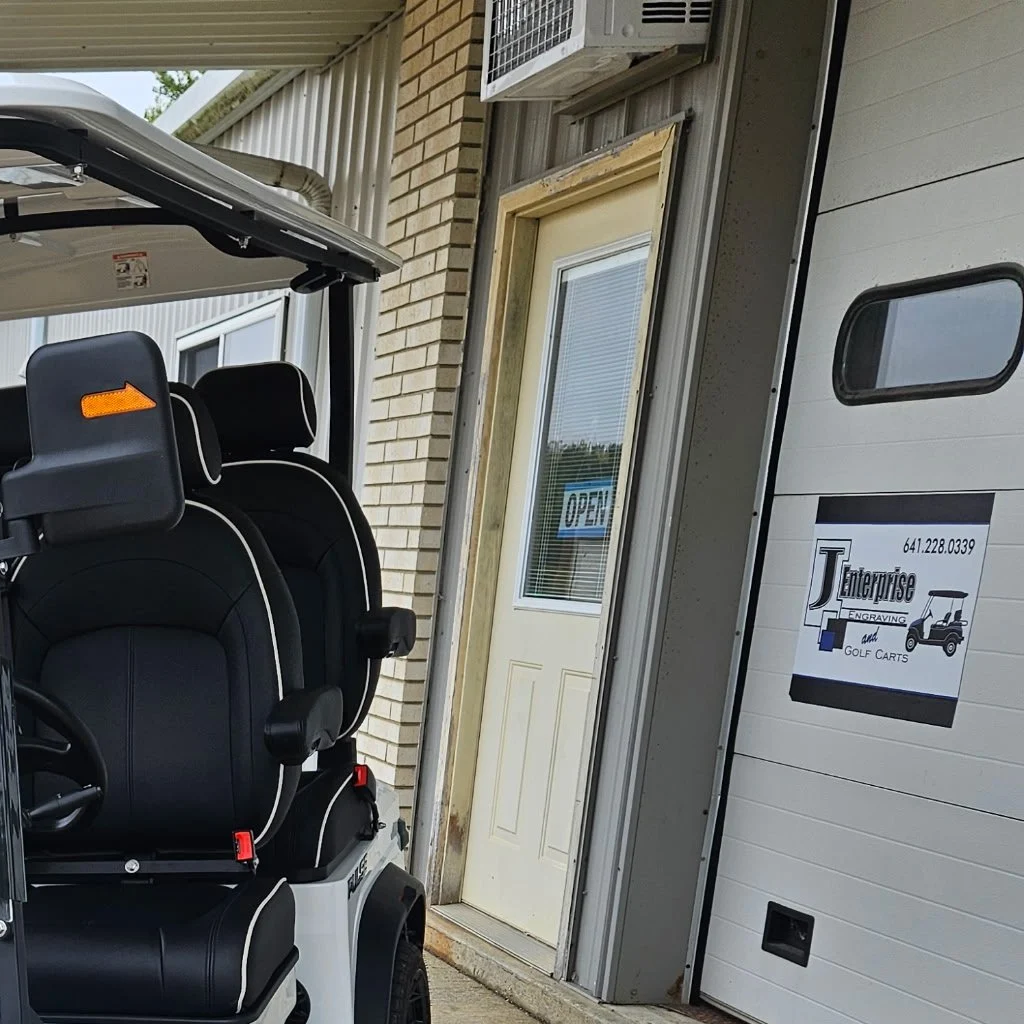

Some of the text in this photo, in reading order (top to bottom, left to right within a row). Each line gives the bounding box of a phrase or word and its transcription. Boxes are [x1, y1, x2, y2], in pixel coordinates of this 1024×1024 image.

[565, 489, 609, 528] OPEN
[903, 537, 976, 556] 641.228.0339
[808, 546, 917, 611] J Enterprise
[848, 610, 906, 624] ENGRAVING
[861, 626, 880, 644] and
[844, 645, 909, 663] GOLF CARTS
